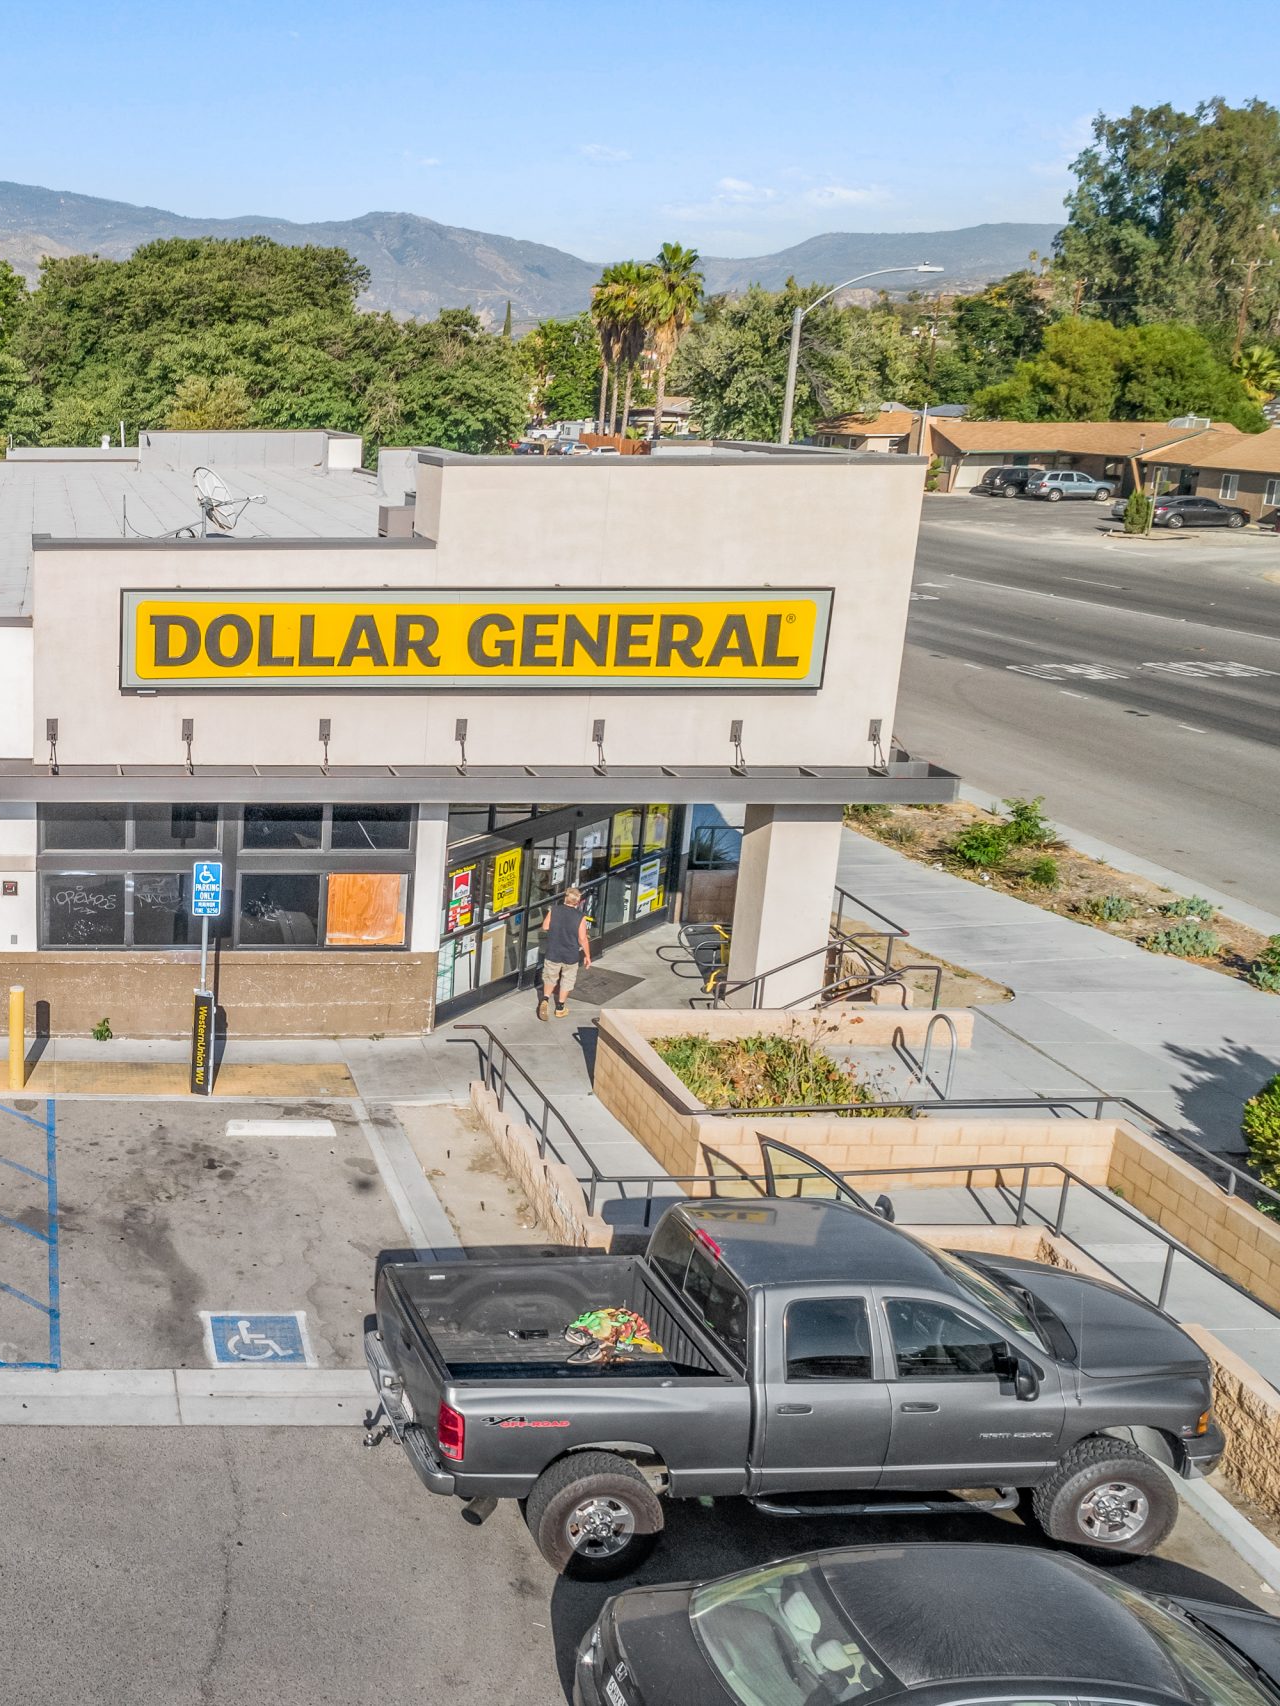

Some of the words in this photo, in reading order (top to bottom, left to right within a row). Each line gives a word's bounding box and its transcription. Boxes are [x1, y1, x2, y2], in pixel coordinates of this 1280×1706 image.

[149, 612, 441, 668] DOLLAR
[467, 613, 799, 667] GENERAL
[498, 857, 517, 876] LOW
[195, 883, 220, 892] PARKING
[199, 892, 215, 900] ONLY
